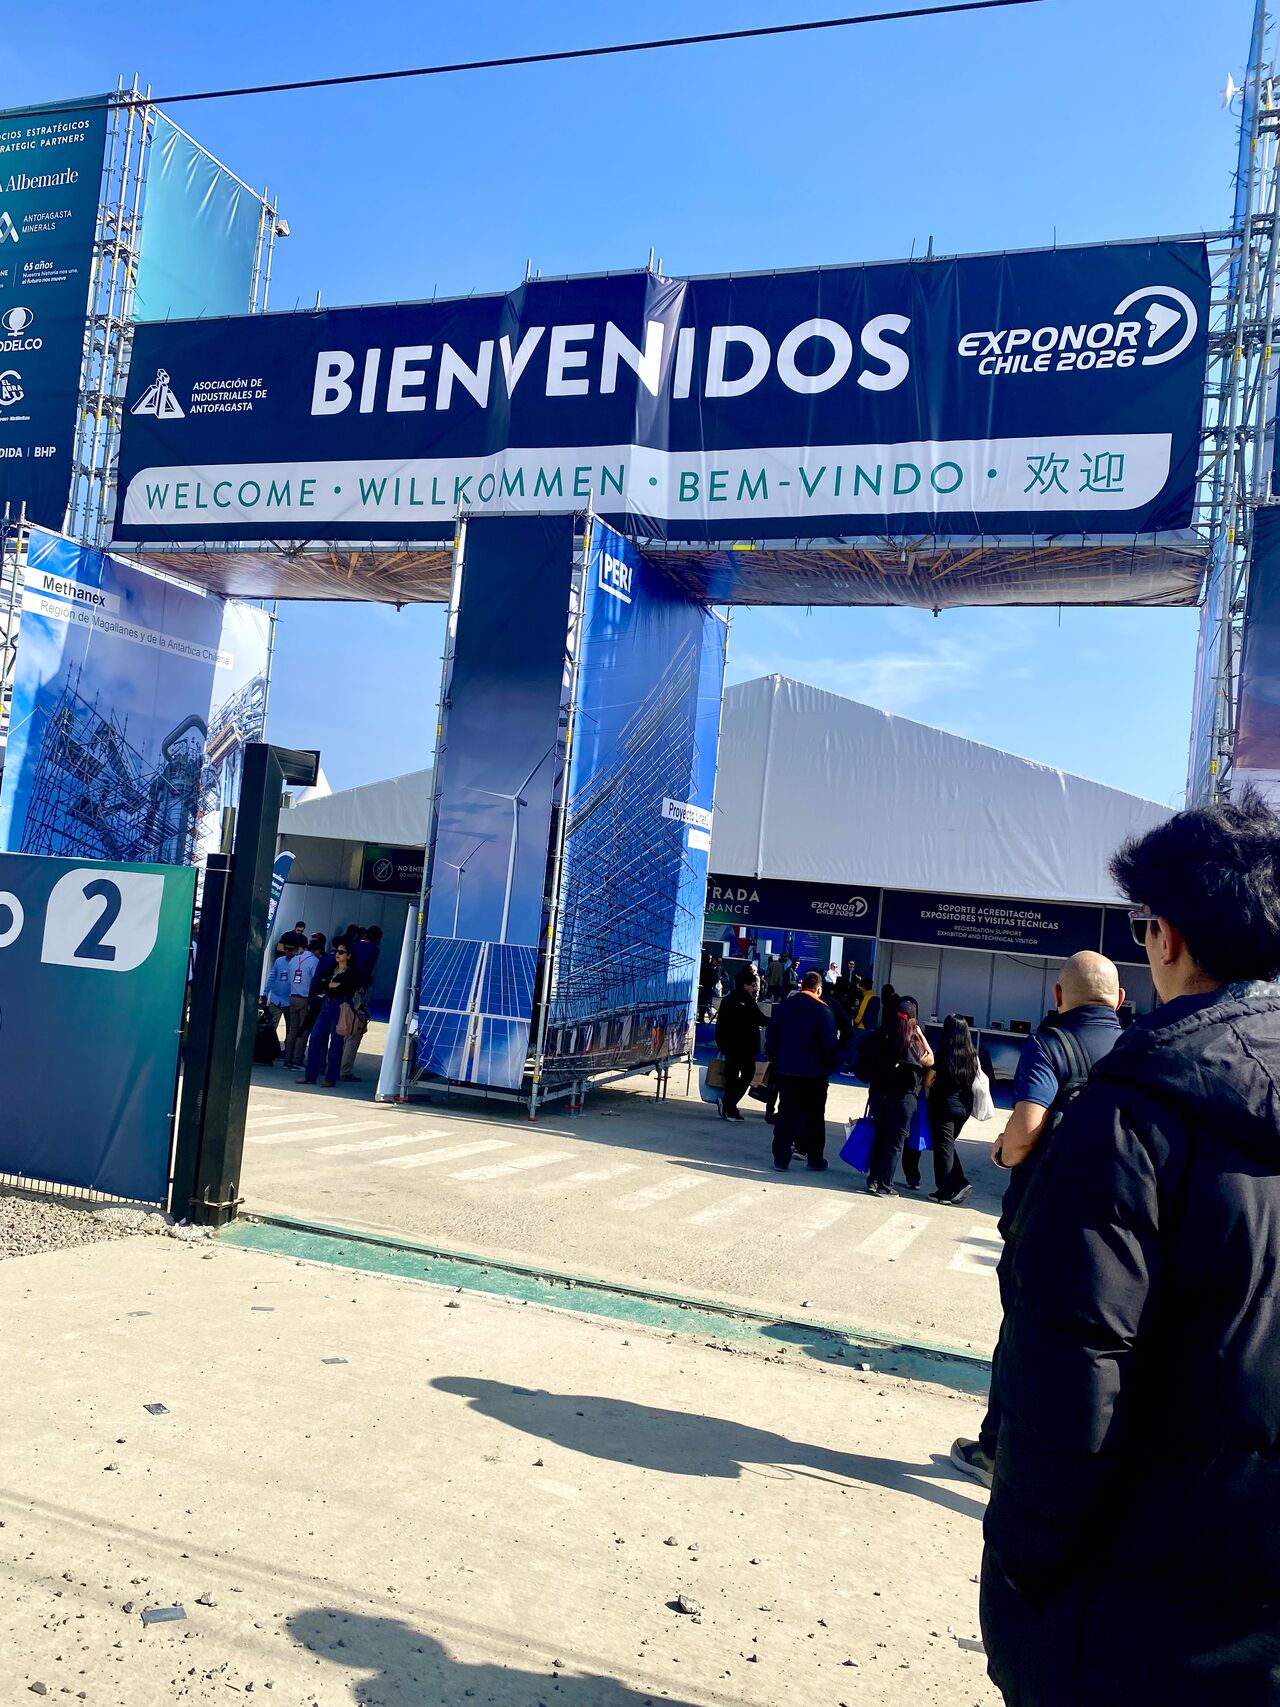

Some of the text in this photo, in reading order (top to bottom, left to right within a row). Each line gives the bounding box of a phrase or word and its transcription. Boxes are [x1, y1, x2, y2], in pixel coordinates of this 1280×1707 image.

[0, 120, 90, 141] CIOS ESTRATÉGICOS
[40, 133, 85, 147] PARTNERS
[5, 167, 79, 192] Albemarle
[23, 210, 72, 222] ANTOFAGASTA
[22, 222, 56, 233] MINERALS
[23, 260, 54, 271] 65 años
[957, 321, 1142, 357] EXPONOR
[310, 313, 912, 416] BIENVENIDOS
[978, 348, 1137, 376] CHILE 2026
[192, 377, 263, 391] ASOCIACIÓN DE
[191, 389, 268, 402] INDUSTRIALES DE
[190, 402, 253, 414] ANTOFAGASTA
[34, 446, 57, 458] BHP
[1023, 451, 1126, 495] 欢迎
[146, 461, 963, 510] WELCOME WILLKOMMEN BEM-VINDO
[604, 552, 633, 593] PERI
[43, 575, 106, 607] Methanex
[40, 599, 230, 666] Región de Magallanes y de la Antártica Chilena
[707, 886, 760, 903] RADA
[811, 901, 855, 911] EXPONOR
[938, 904, 1041, 920] SOPORTE ACREDITACIÓN
[73, 878, 123, 962] 2
[920, 910, 1059, 930] EXPOSITORES Y VISITAS TÉCNICAS
[937, 930, 967, 938] EXHIBITOR
[981, 934, 1014, 943] TECHNICAL
[1014, 937, 1039, 945] VISITOR
[953, 925, 1022, 937] REGISTRATION SUPPORT
